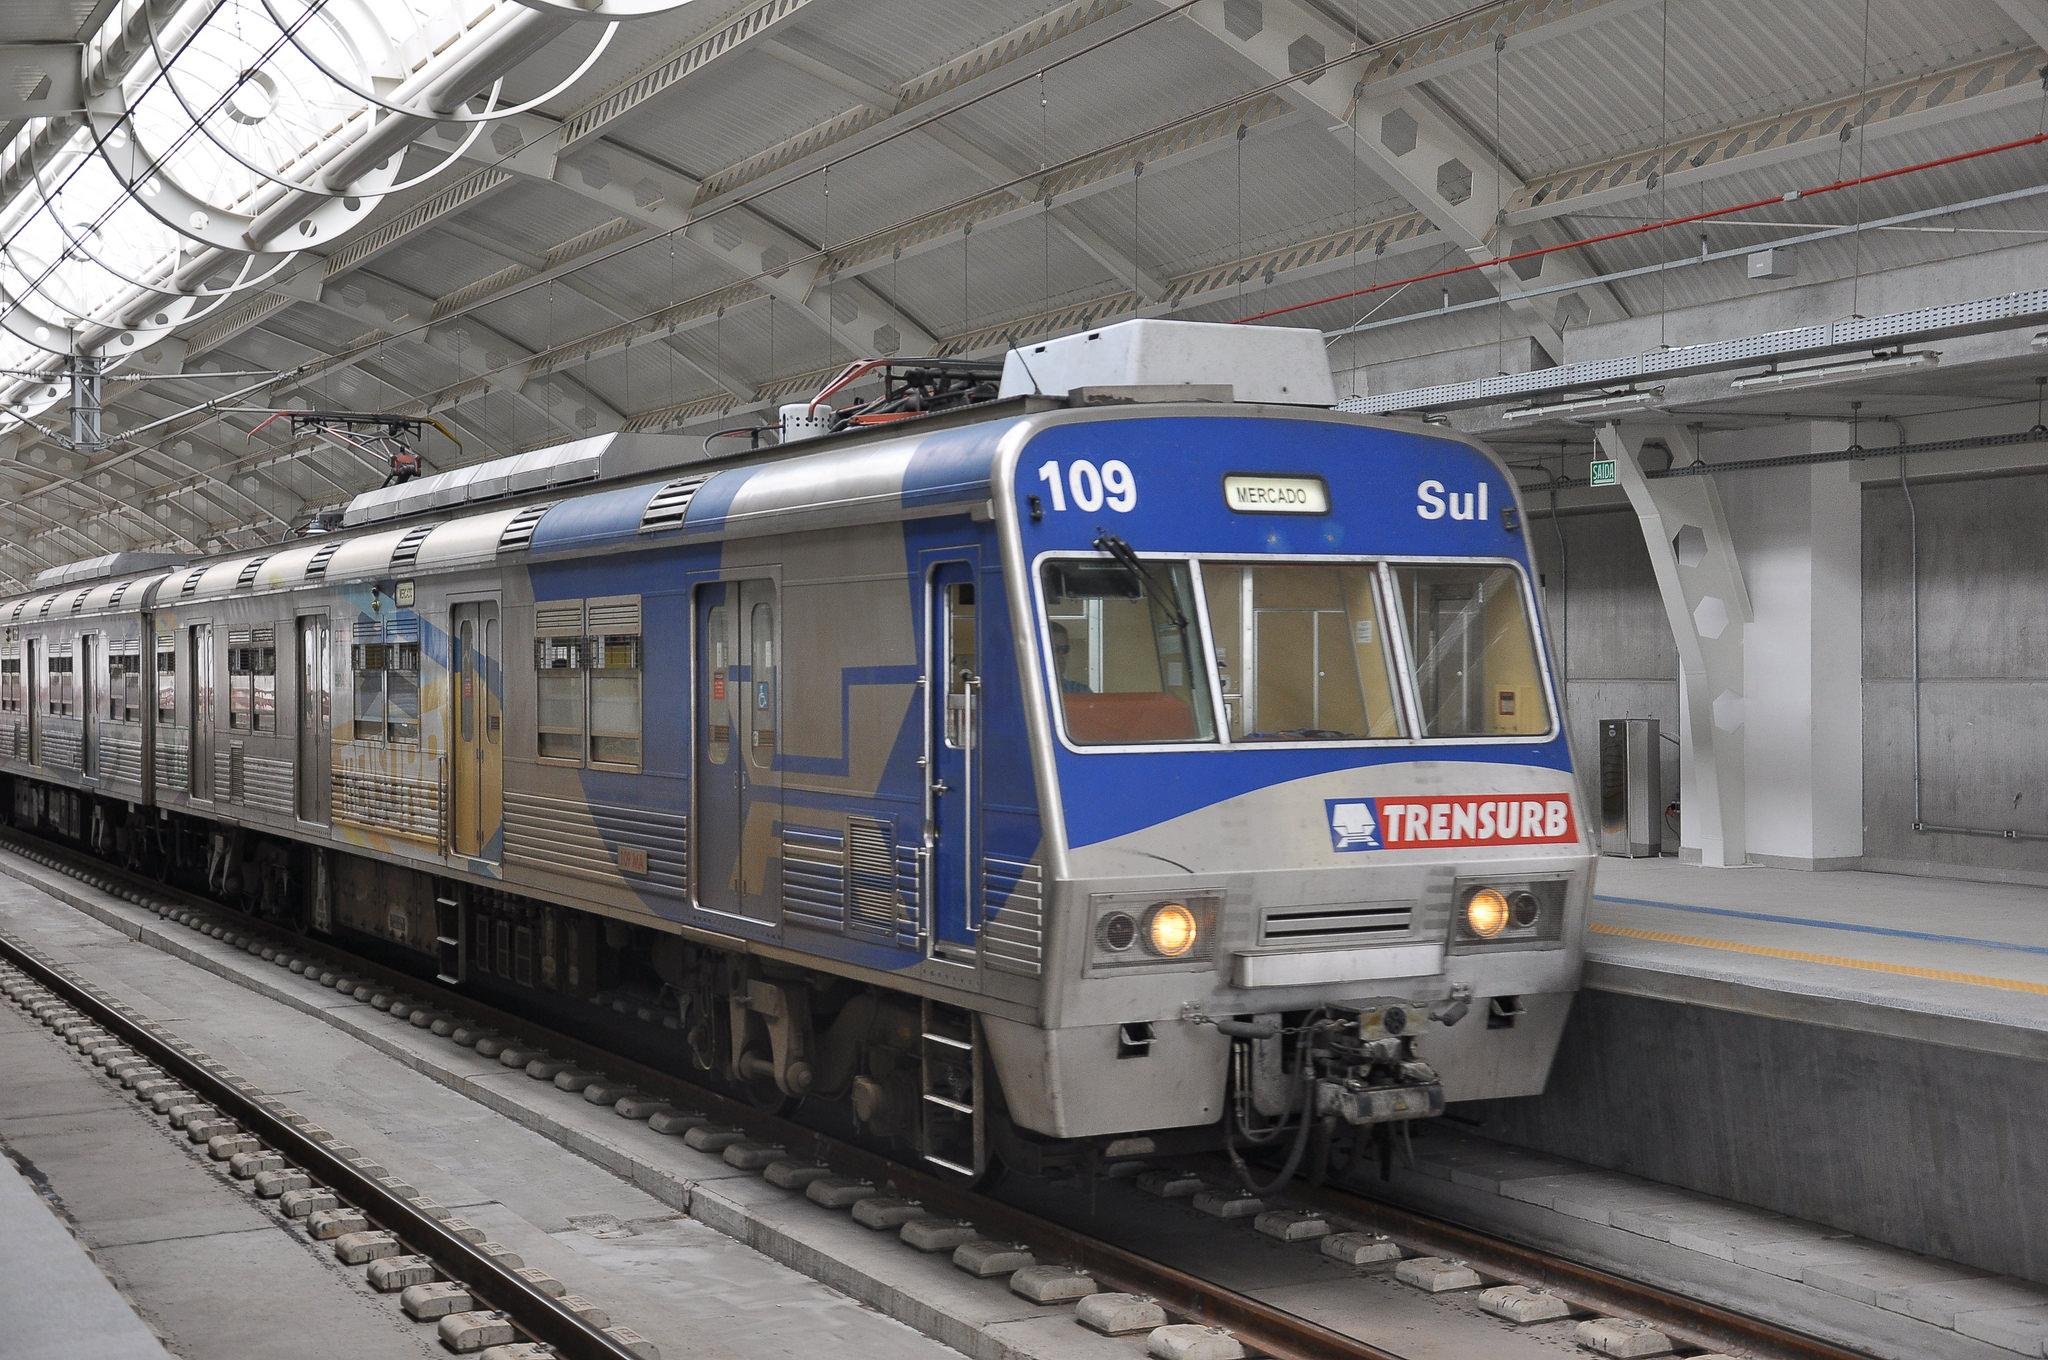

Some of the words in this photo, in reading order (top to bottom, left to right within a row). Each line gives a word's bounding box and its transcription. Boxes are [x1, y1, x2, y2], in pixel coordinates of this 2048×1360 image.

[1038, 459, 1137, 513] 109
[1236, 487, 1307, 504] MERCADO
[1416, 479, 1488, 520] Sul
[1383, 800, 1568, 842] TRENSURB
